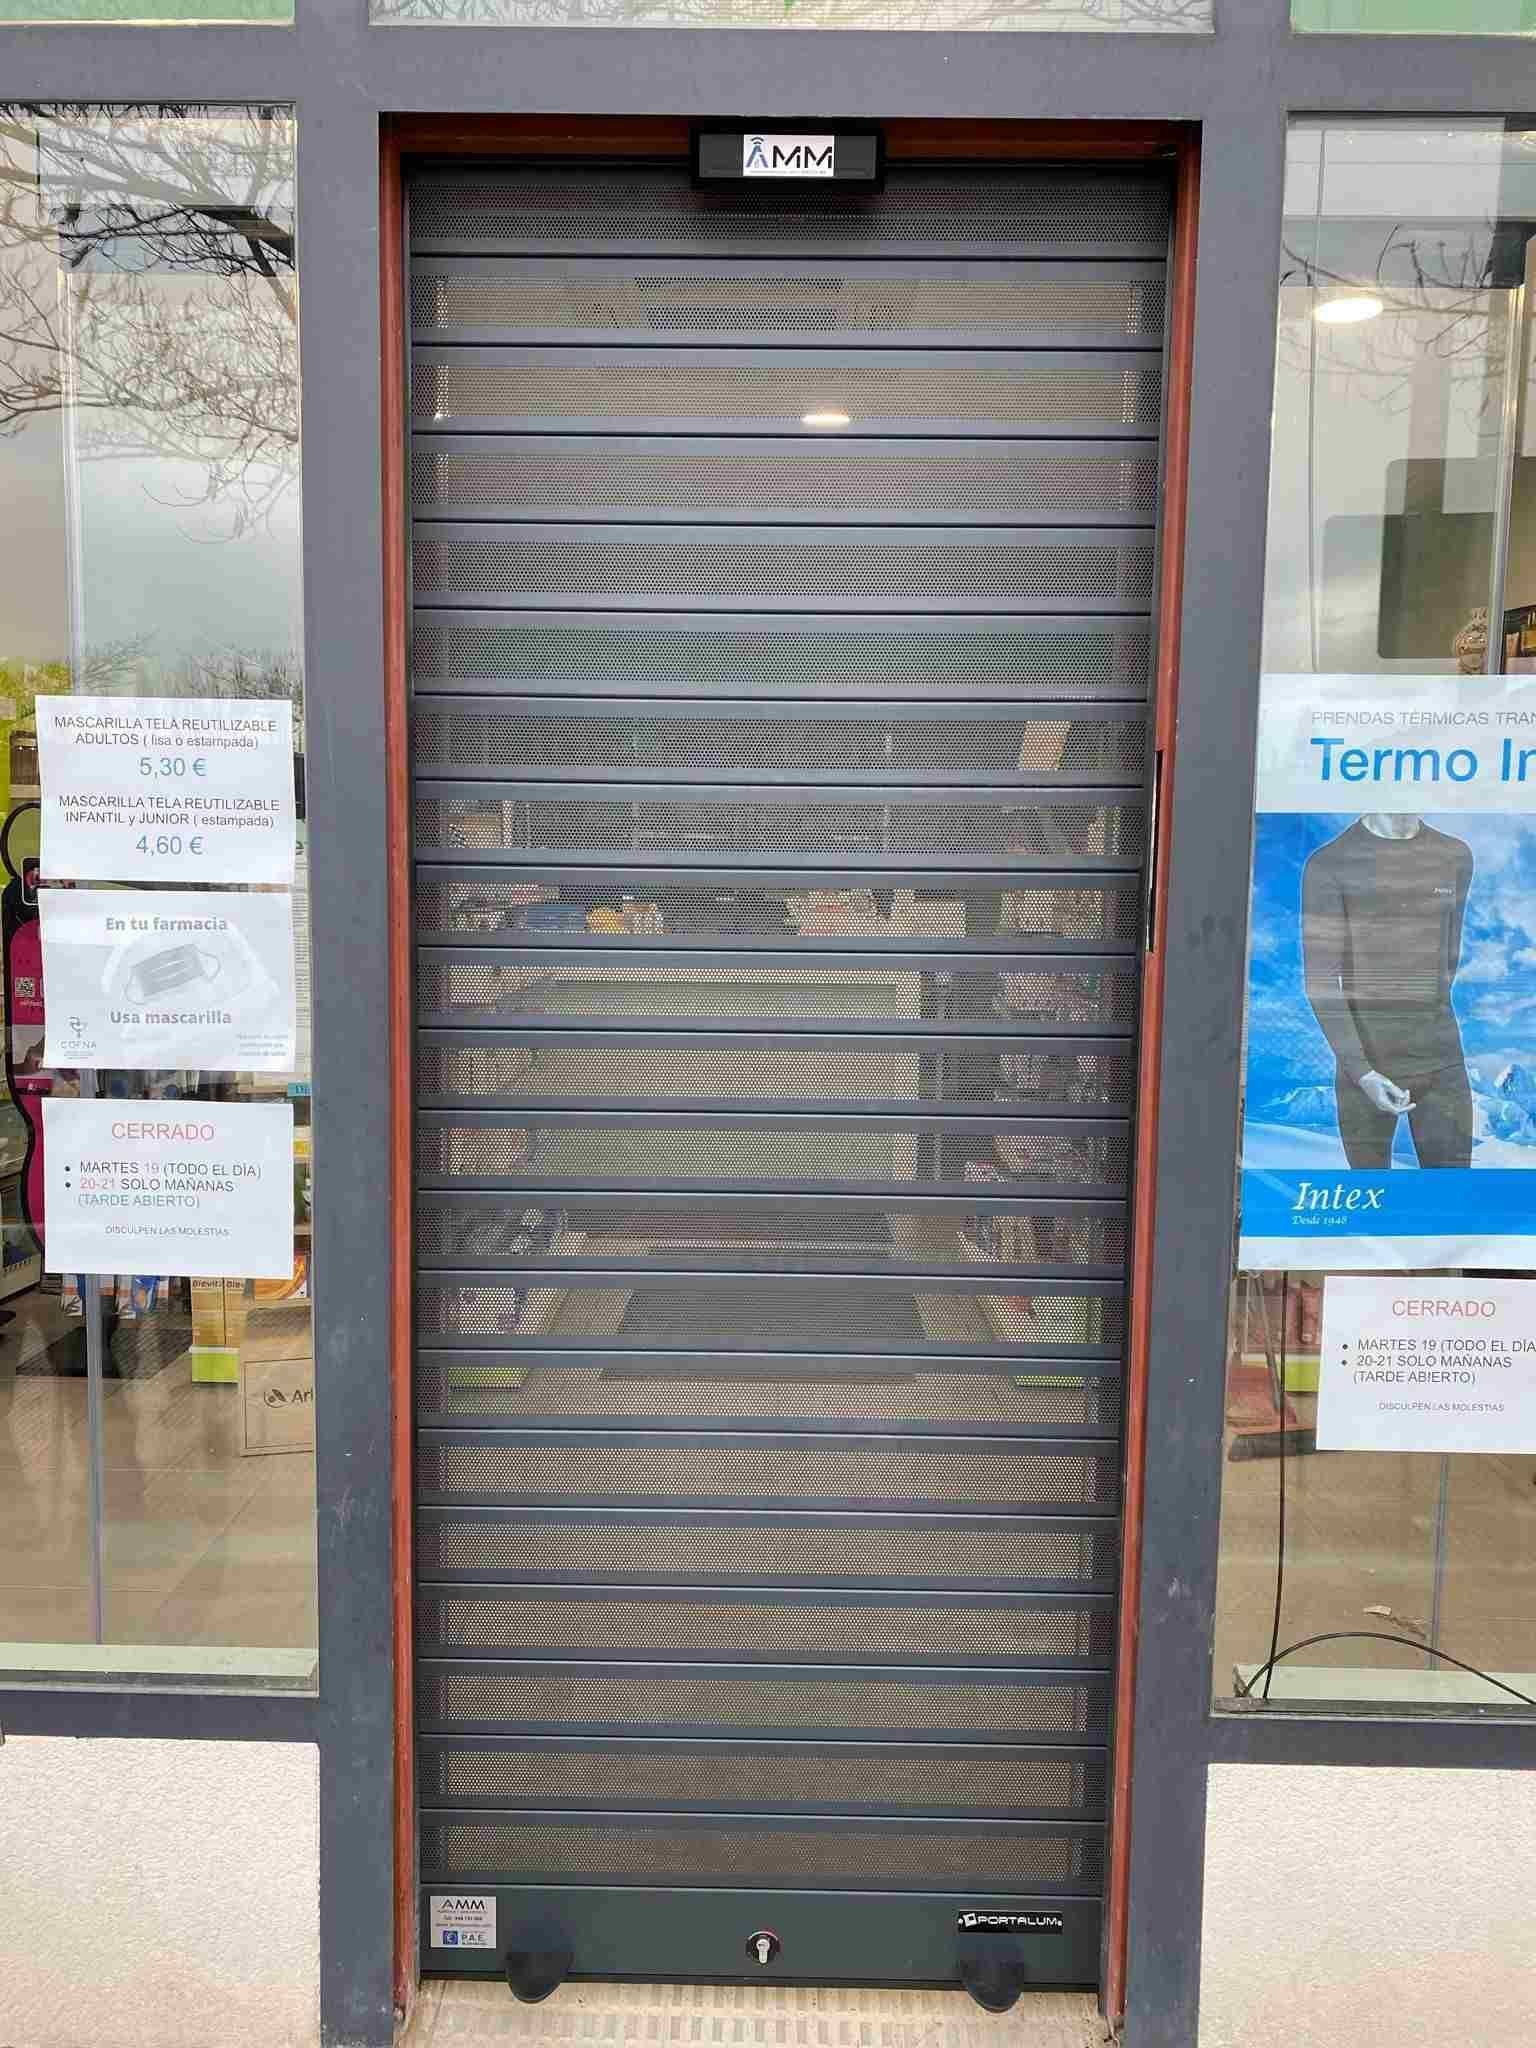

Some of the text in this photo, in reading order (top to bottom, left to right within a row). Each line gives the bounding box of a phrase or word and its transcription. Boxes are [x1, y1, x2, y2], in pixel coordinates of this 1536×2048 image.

[745, 143, 833, 169] AMM
[54, 716, 278, 732] MASCARILLA TELA REUTILIZABLE
[1311, 711, 1395, 726] PRENDAS
[1399, 708, 1489, 726] TÉRMICAS
[75, 733, 139, 745] ADULTOS
[151, 735, 172, 746] lisa
[175, 737, 183, 746] o
[186, 735, 259, 750] estampada)
[139, 756, 208, 778] 5,30 €
[1310, 737, 1478, 782] Termo
[58, 795, 280, 811] MASCARILLA TELA REUTILIZABLE
[65, 811, 126, 824] INFANTIL
[139, 812, 190, 825] JUNIOR
[202, 814, 275, 829] estampada)
[136, 835, 204, 857] 4,60 €
[105, 916, 229, 931] En tu farmacia
[110, 1009, 233, 1025] Usa mascarilla
[111, 1122, 215, 1142] CERRADO
[79, 1161, 262, 1178] MARTES 19 (TODO EL DÍA)
[80, 1176, 235, 1192] 20-21 SOLO MAÑANAS
[78, 1193, 201, 1208] (TARDE ABIERTO)
[1291, 1182, 1385, 1211] Intex
[105, 1225, 158, 1235] DISCULPEN
[178, 1226, 230, 1236] MOLESTIAS
[1392, 1300, 1497, 1318] CERRADO
[1357, 1339, 1417, 1352] MARTES
[1422, 1340, 1437, 1352] 19
[1441, 1339, 1487, 1354] (TODO
[1491, 1340, 1509, 1353] EL
[1356, 1353, 1513, 1369] 20-21 SOLO MAÑANAS
[1353, 1370, 1476, 1385] (TARDE ABIERTO)
[1378, 1402, 1432, 1412] DISCULPEN
[1452, 1403, 1505, 1413] MOLESTIAS
[441, 1898, 485, 1910] AMM
[977, 1915, 1058, 1927] PORTALUM
